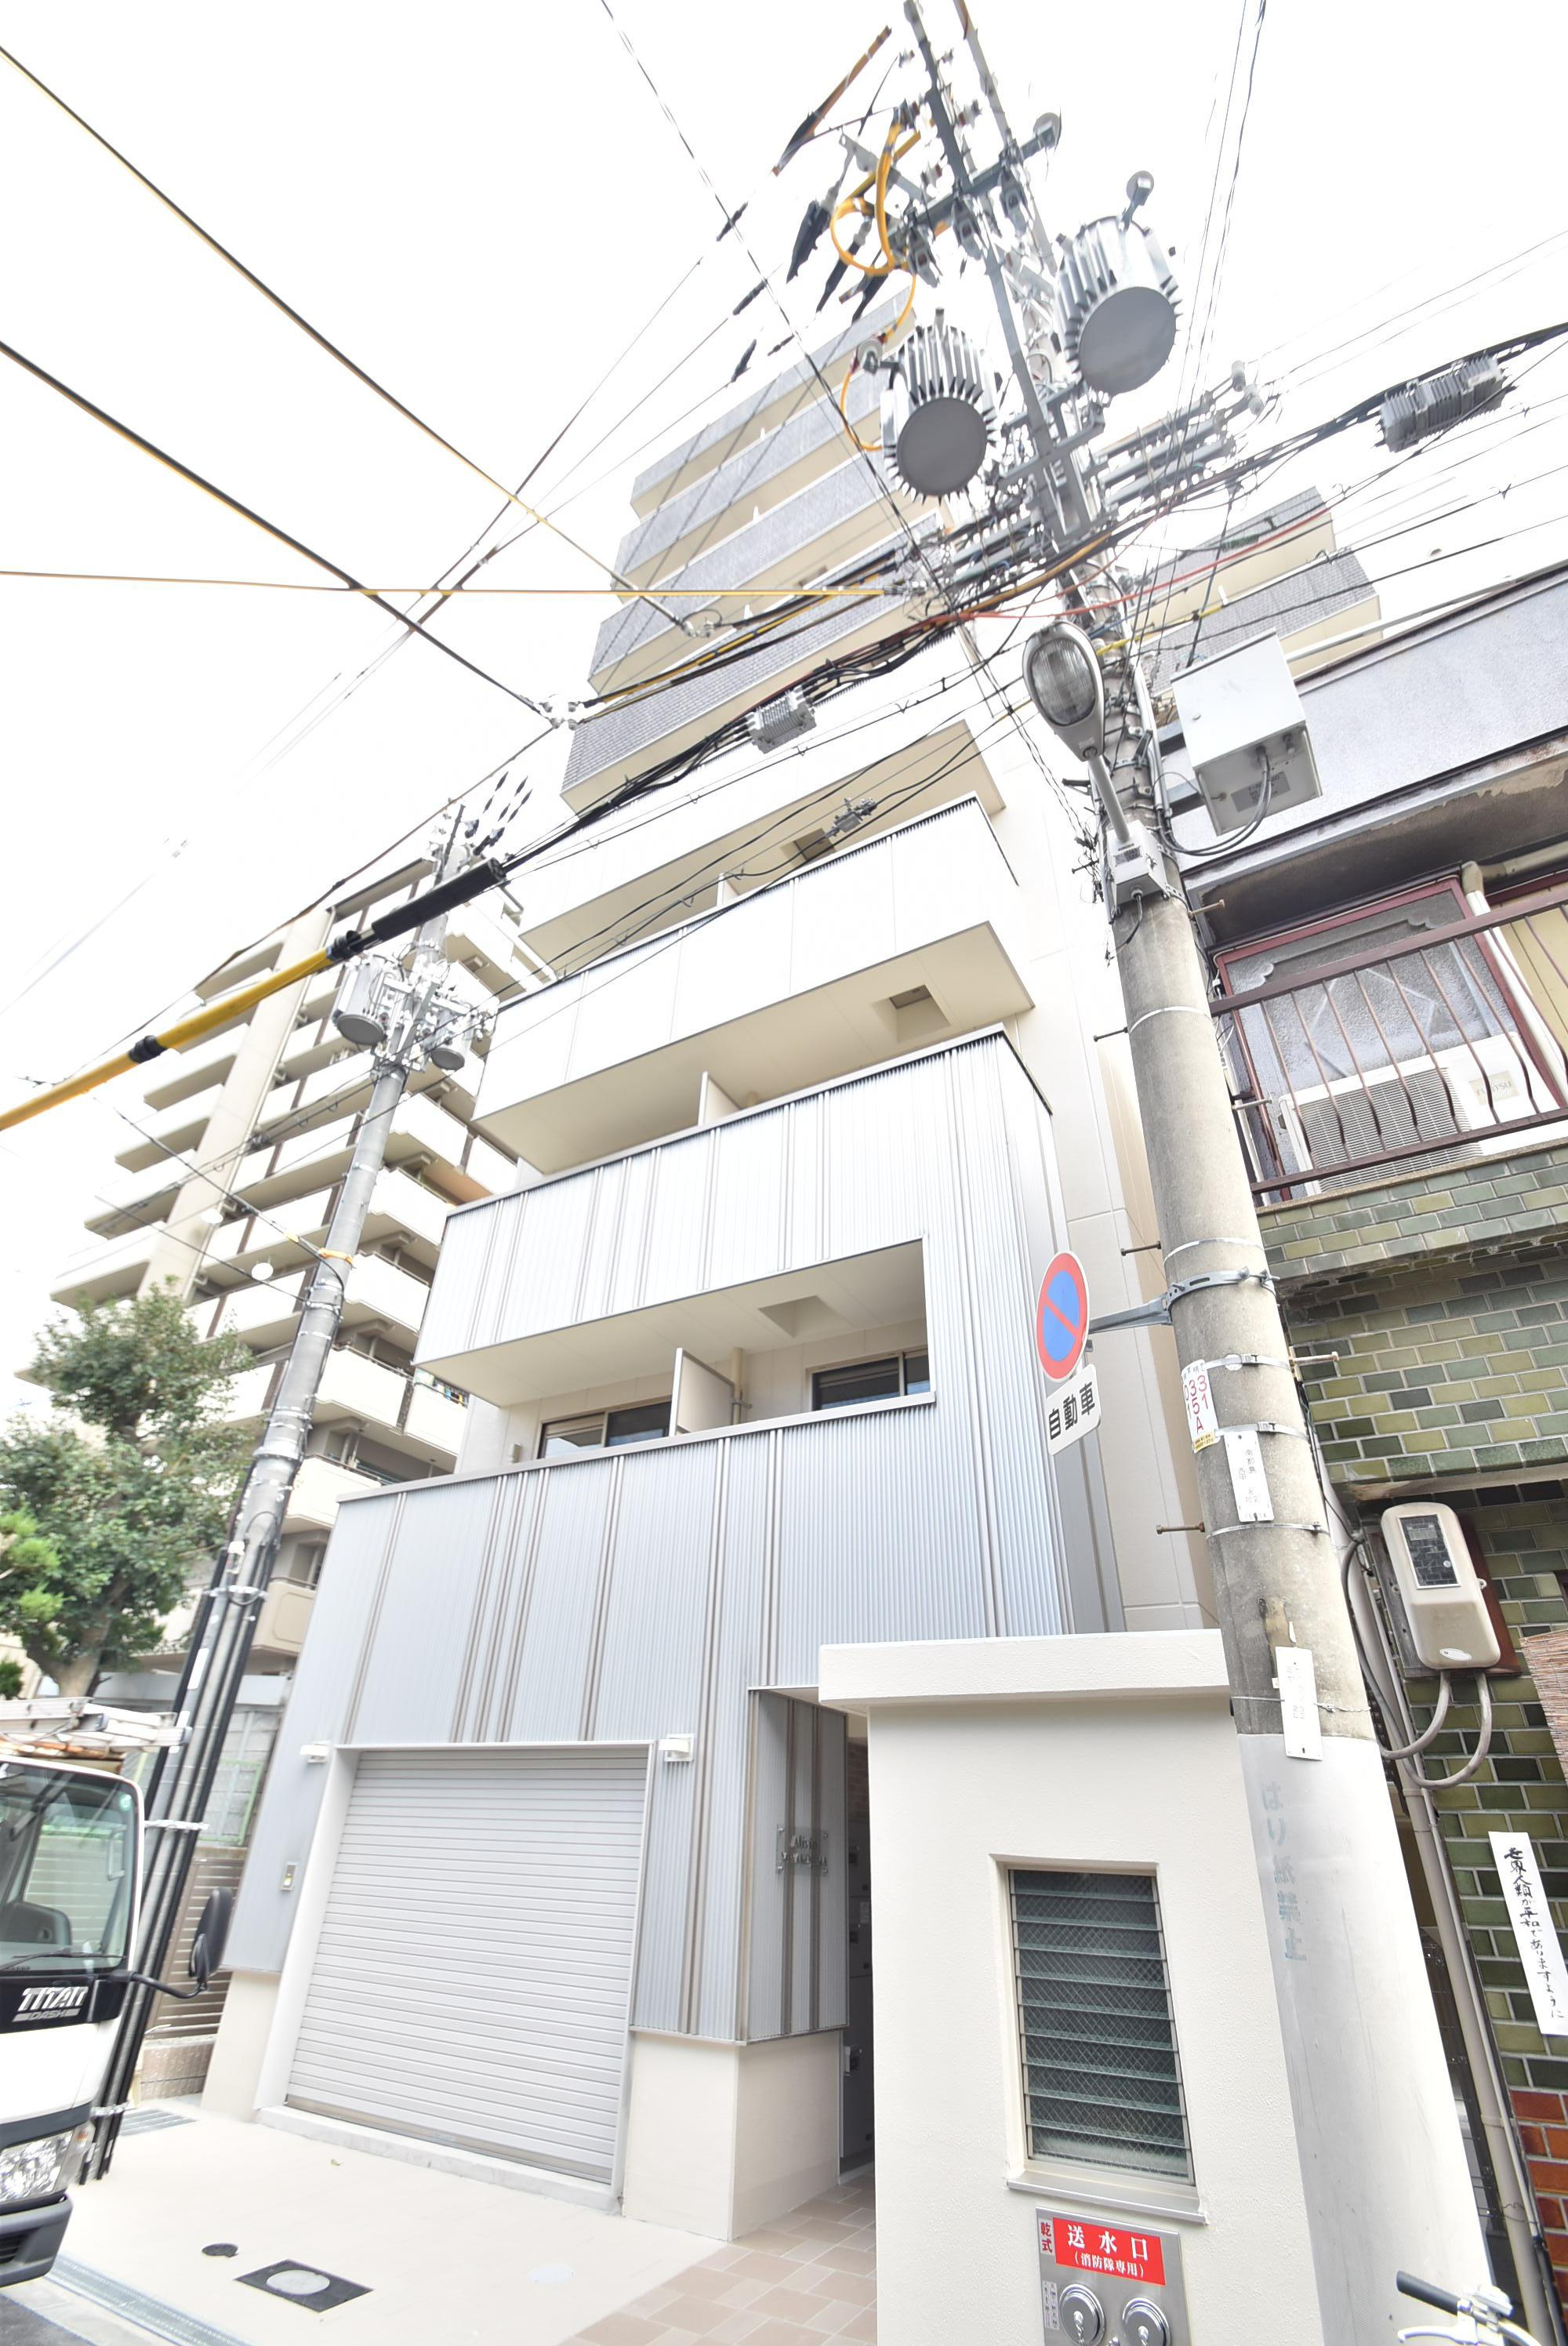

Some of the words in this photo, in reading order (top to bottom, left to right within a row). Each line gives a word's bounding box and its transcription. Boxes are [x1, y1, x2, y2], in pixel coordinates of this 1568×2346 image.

[1048, 1381, 1095, 1440] 自動車
[1503, 1846, 1564, 2019] 世界人類が平和でありますように
[17, 1985, 89, 2012] TITAN
[1040, 2221, 1053, 2253] 乾式
[1067, 2224, 1148, 2261] 送水口
